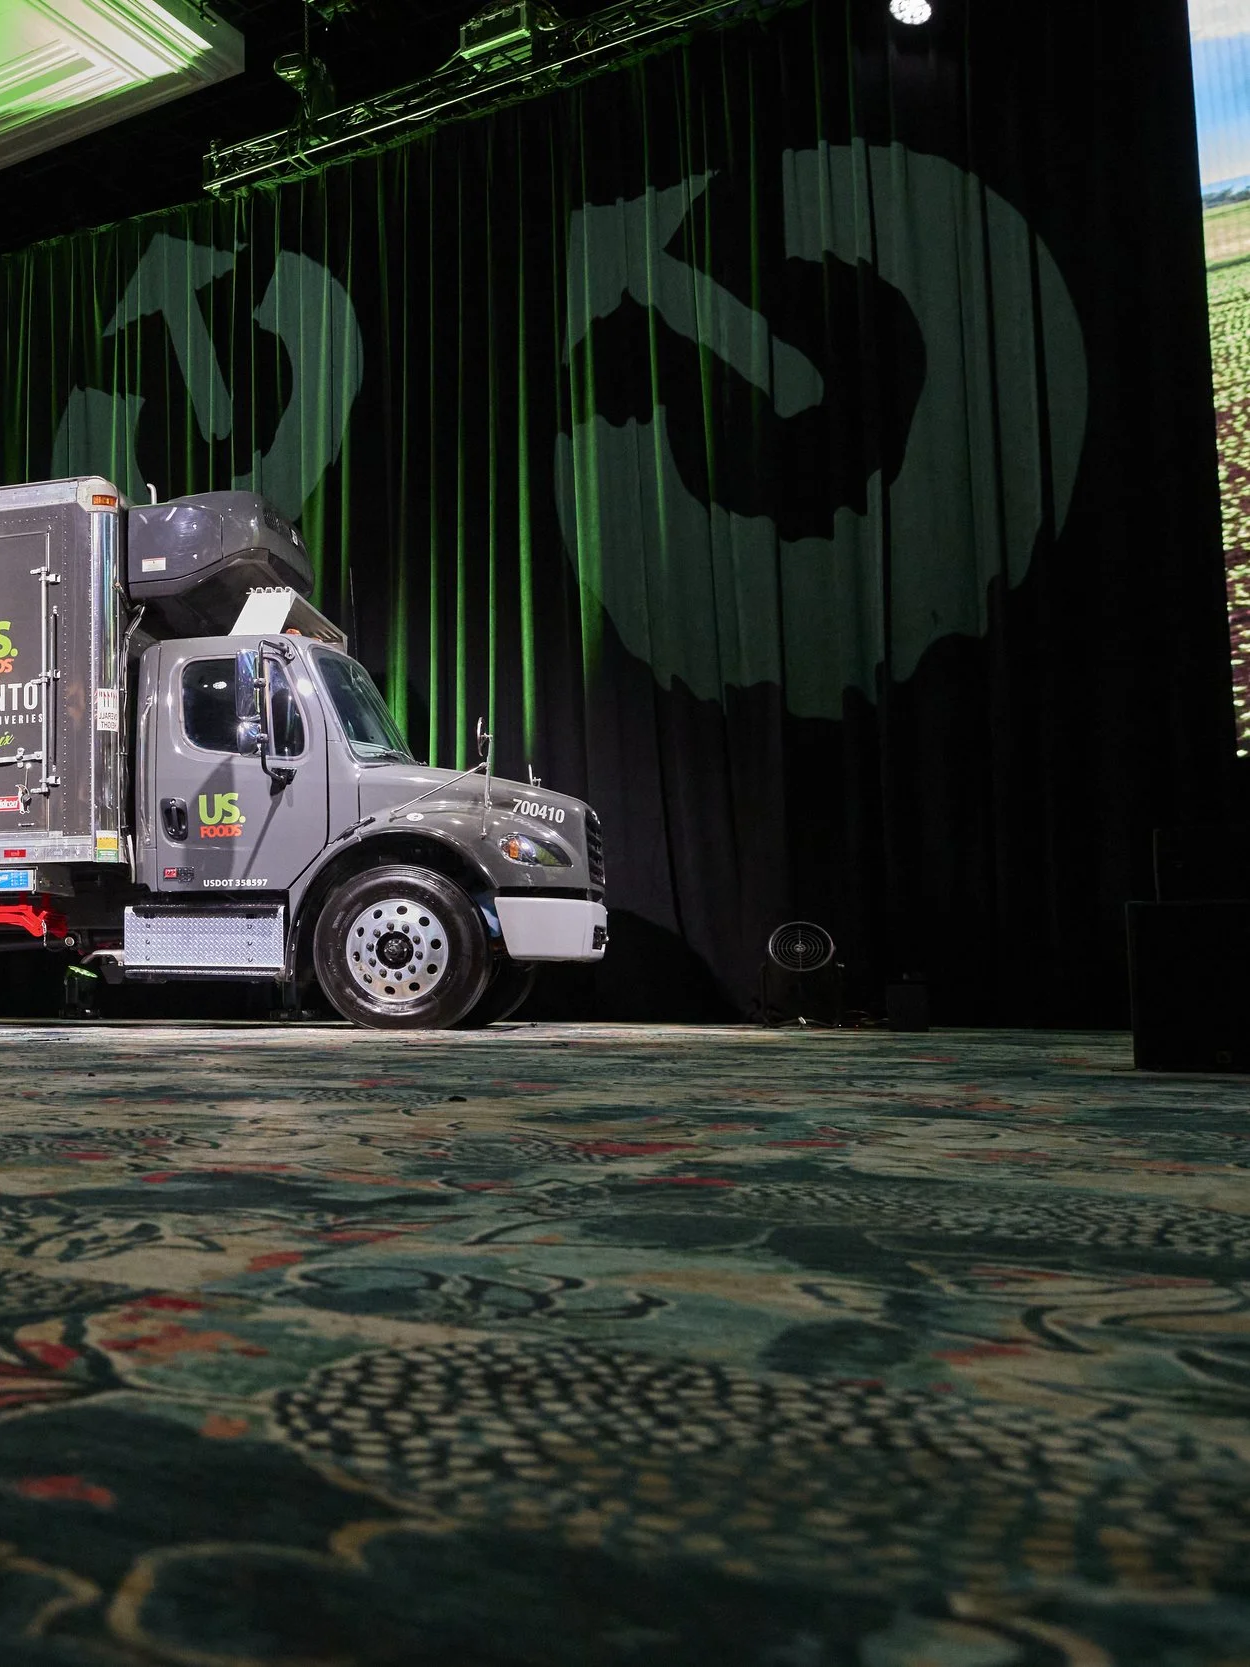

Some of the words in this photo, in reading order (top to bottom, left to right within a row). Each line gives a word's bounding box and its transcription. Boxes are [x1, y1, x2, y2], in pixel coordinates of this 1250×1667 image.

[512, 798, 566, 824] 700410
[200, 824, 242, 839] FOODS
[203, 879, 234, 887] USDOT
[235, 878, 268, 887] 358597
